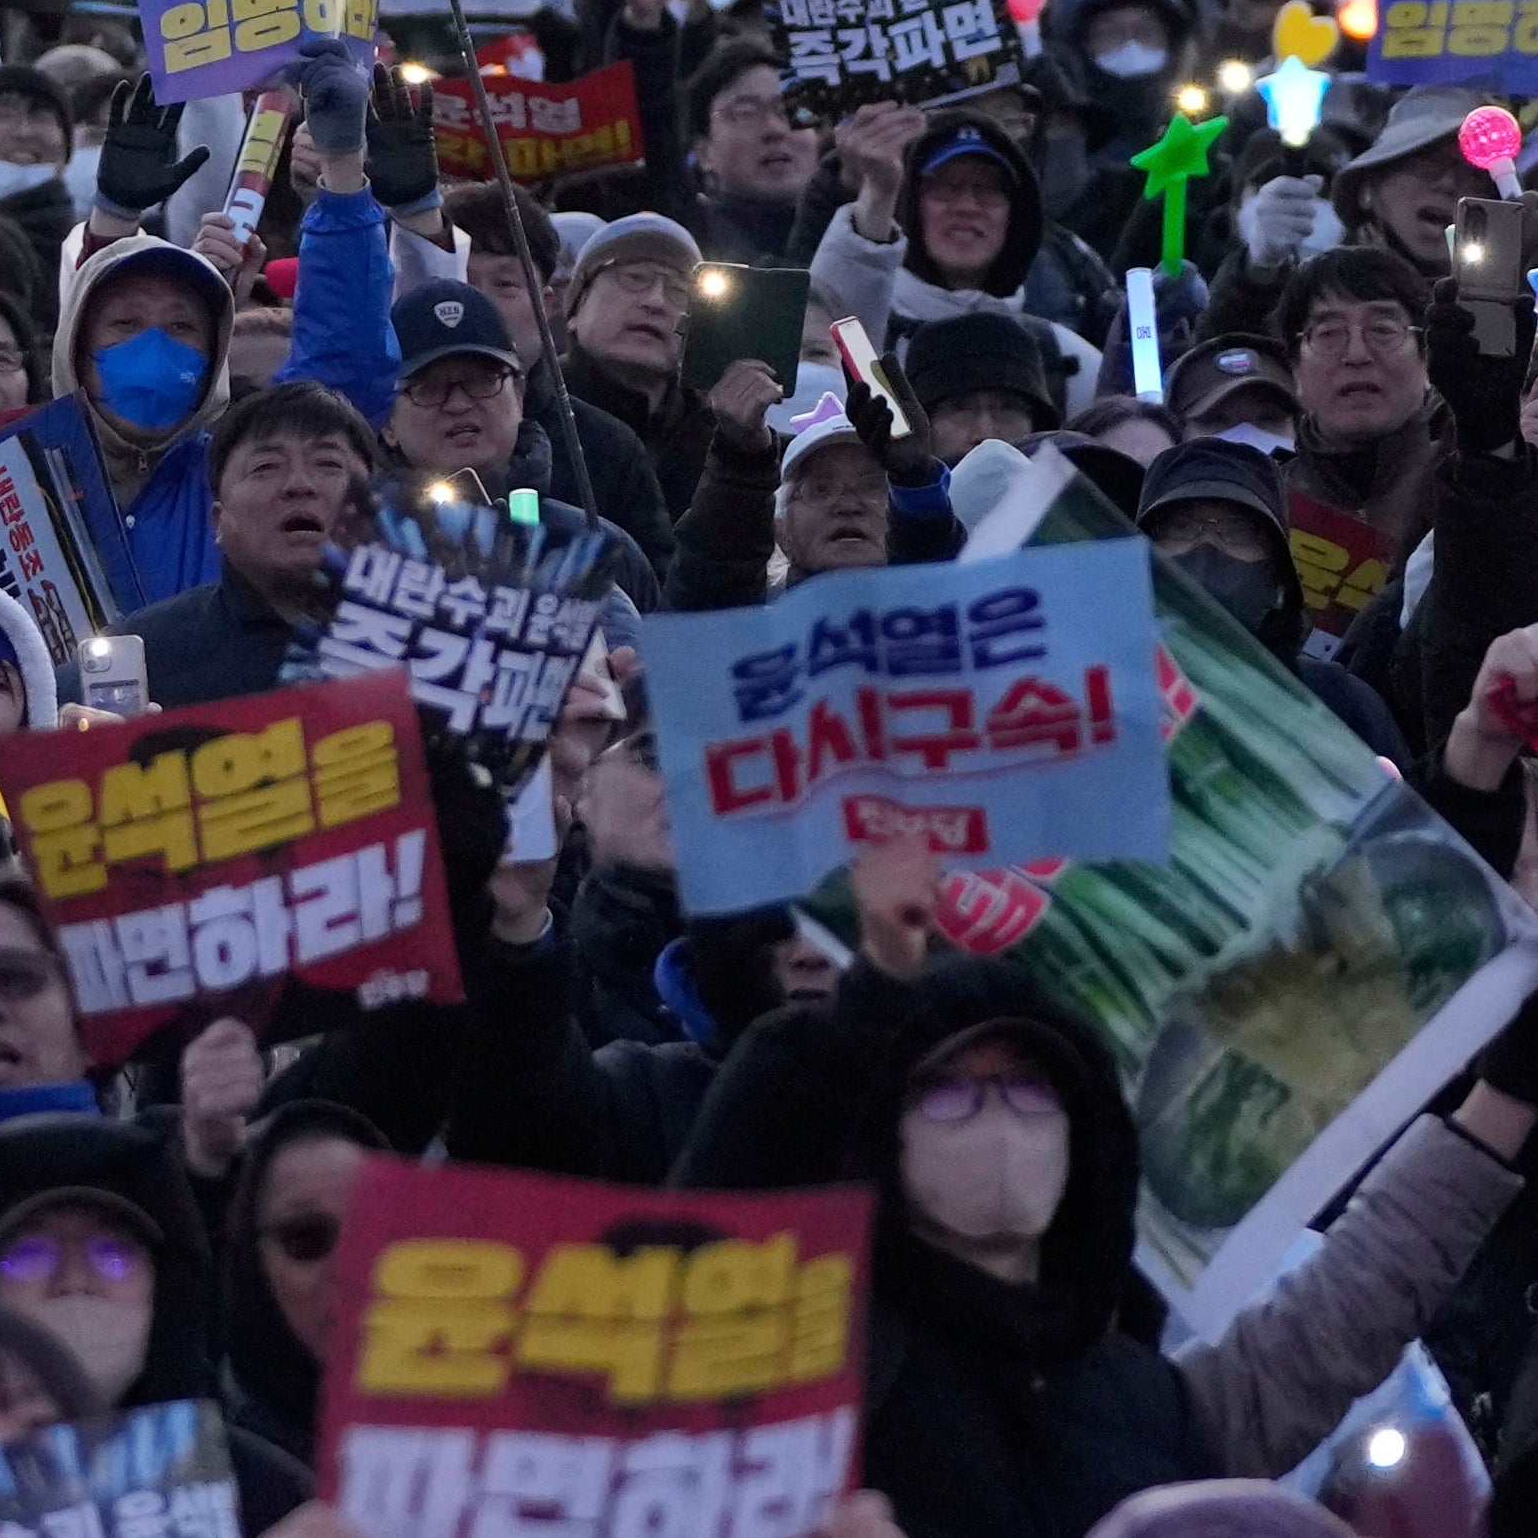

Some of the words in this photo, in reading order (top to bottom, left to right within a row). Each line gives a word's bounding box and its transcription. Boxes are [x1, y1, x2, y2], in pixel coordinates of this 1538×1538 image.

[343, 541, 531, 639] 내란수괴
[729, 584, 1048, 722] 윤석열은
[20, 716, 400, 899] 윤석열을
[704, 663, 1119, 819] 다시구속!
[58, 827, 427, 1015] 파면하라!
[354, 1230, 857, 1408] 윤석열을
